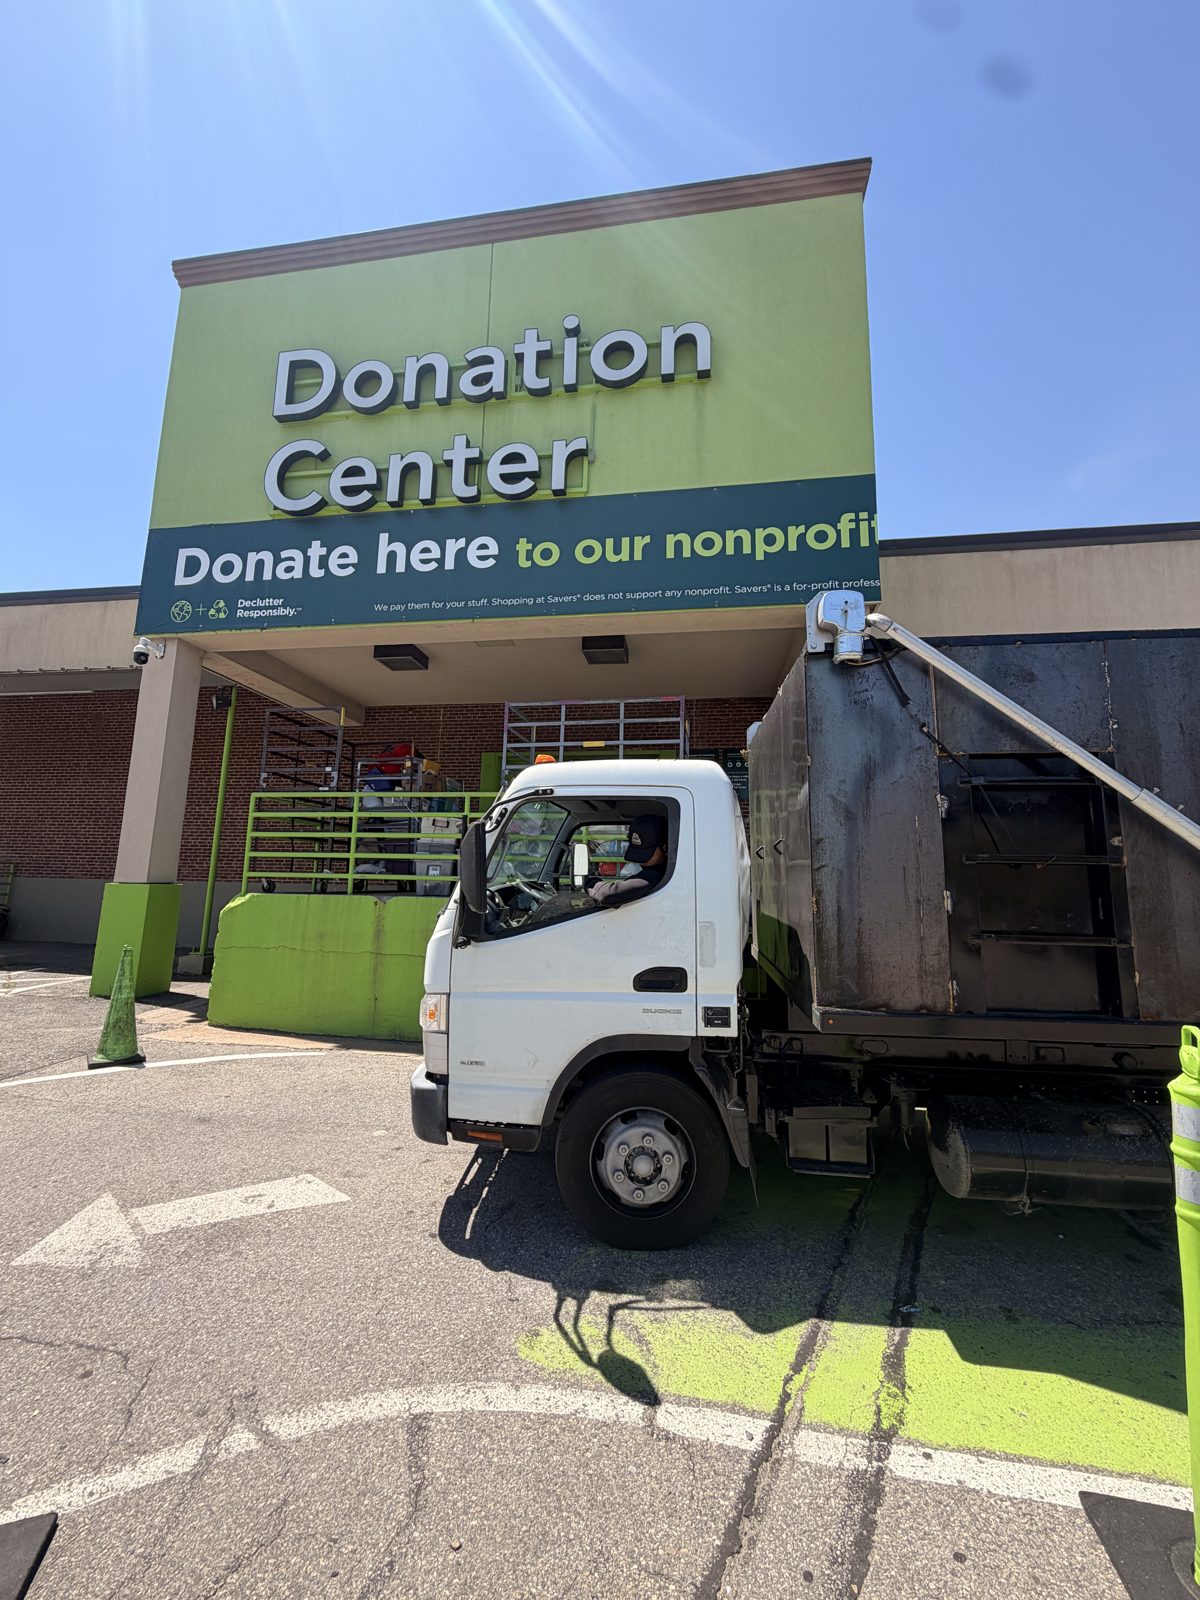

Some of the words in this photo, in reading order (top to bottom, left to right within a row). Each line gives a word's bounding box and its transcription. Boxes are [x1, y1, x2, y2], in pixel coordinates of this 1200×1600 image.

[272, 314, 711, 423] Donation
[263, 433, 589, 517] Center
[174, 540, 358, 586] Donate
[375, 532, 500, 575] here
[515, 537, 561, 568] to
[574, 534, 652, 565] our
[238, 598, 284, 608] Declutter
[374, 603, 389, 612] We
[390, 603, 406, 613] pay
[407, 601, 430, 610] them
[431, 600, 444, 609] for
[446, 601, 466, 610] your
[467, 598, 490, 608] stuff.
[491, 596, 534, 607] Shopping
[536, 596, 546, 604] at
[582, 593, 606, 601] does
[607, 592, 624, 600] not
[626, 589, 663, 601] support
[664, 589, 683, 598] any
[684, 584, 732, 597] nonprofit.
[774, 583, 782, 592] is
[793, 580, 840, 592] for-profit
